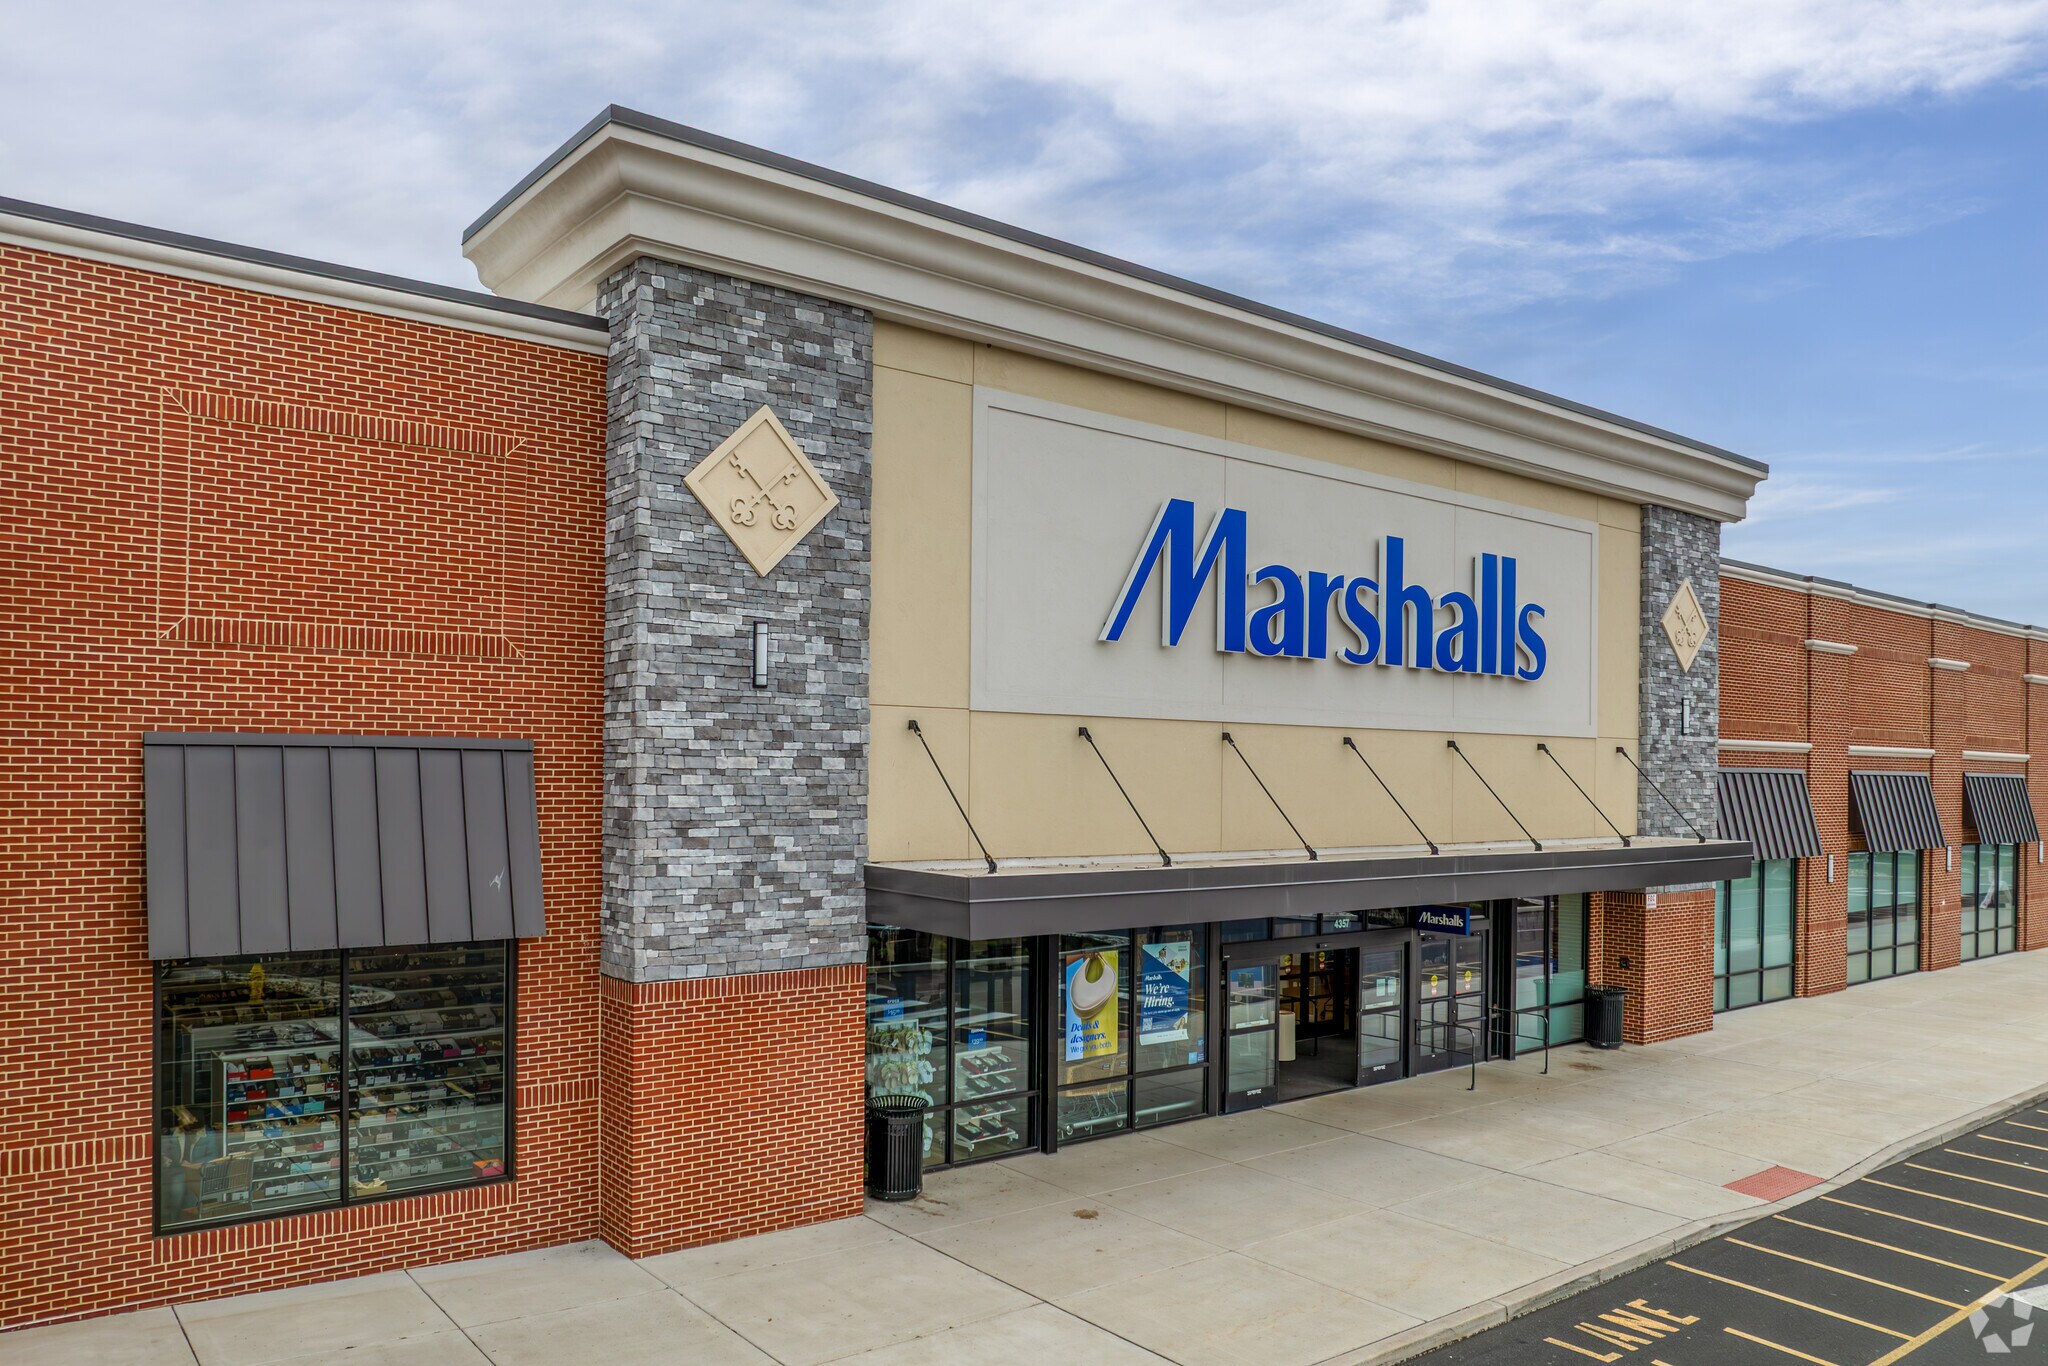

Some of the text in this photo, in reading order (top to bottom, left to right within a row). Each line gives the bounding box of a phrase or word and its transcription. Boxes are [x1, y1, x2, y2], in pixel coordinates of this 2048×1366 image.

[1098, 498, 1547, 682] Marshalls
[1334, 918, 1350, 929] 4357
[1419, 911, 1464, 927] Marshalls
[1145, 983, 1170, 995] We're
[1144, 996, 1175, 1008] Hiring.
[1071, 1020, 1099, 1032] Deals &
[1071, 1045, 1079, 1053] We
[1543, 1298, 1700, 1363] LANE
